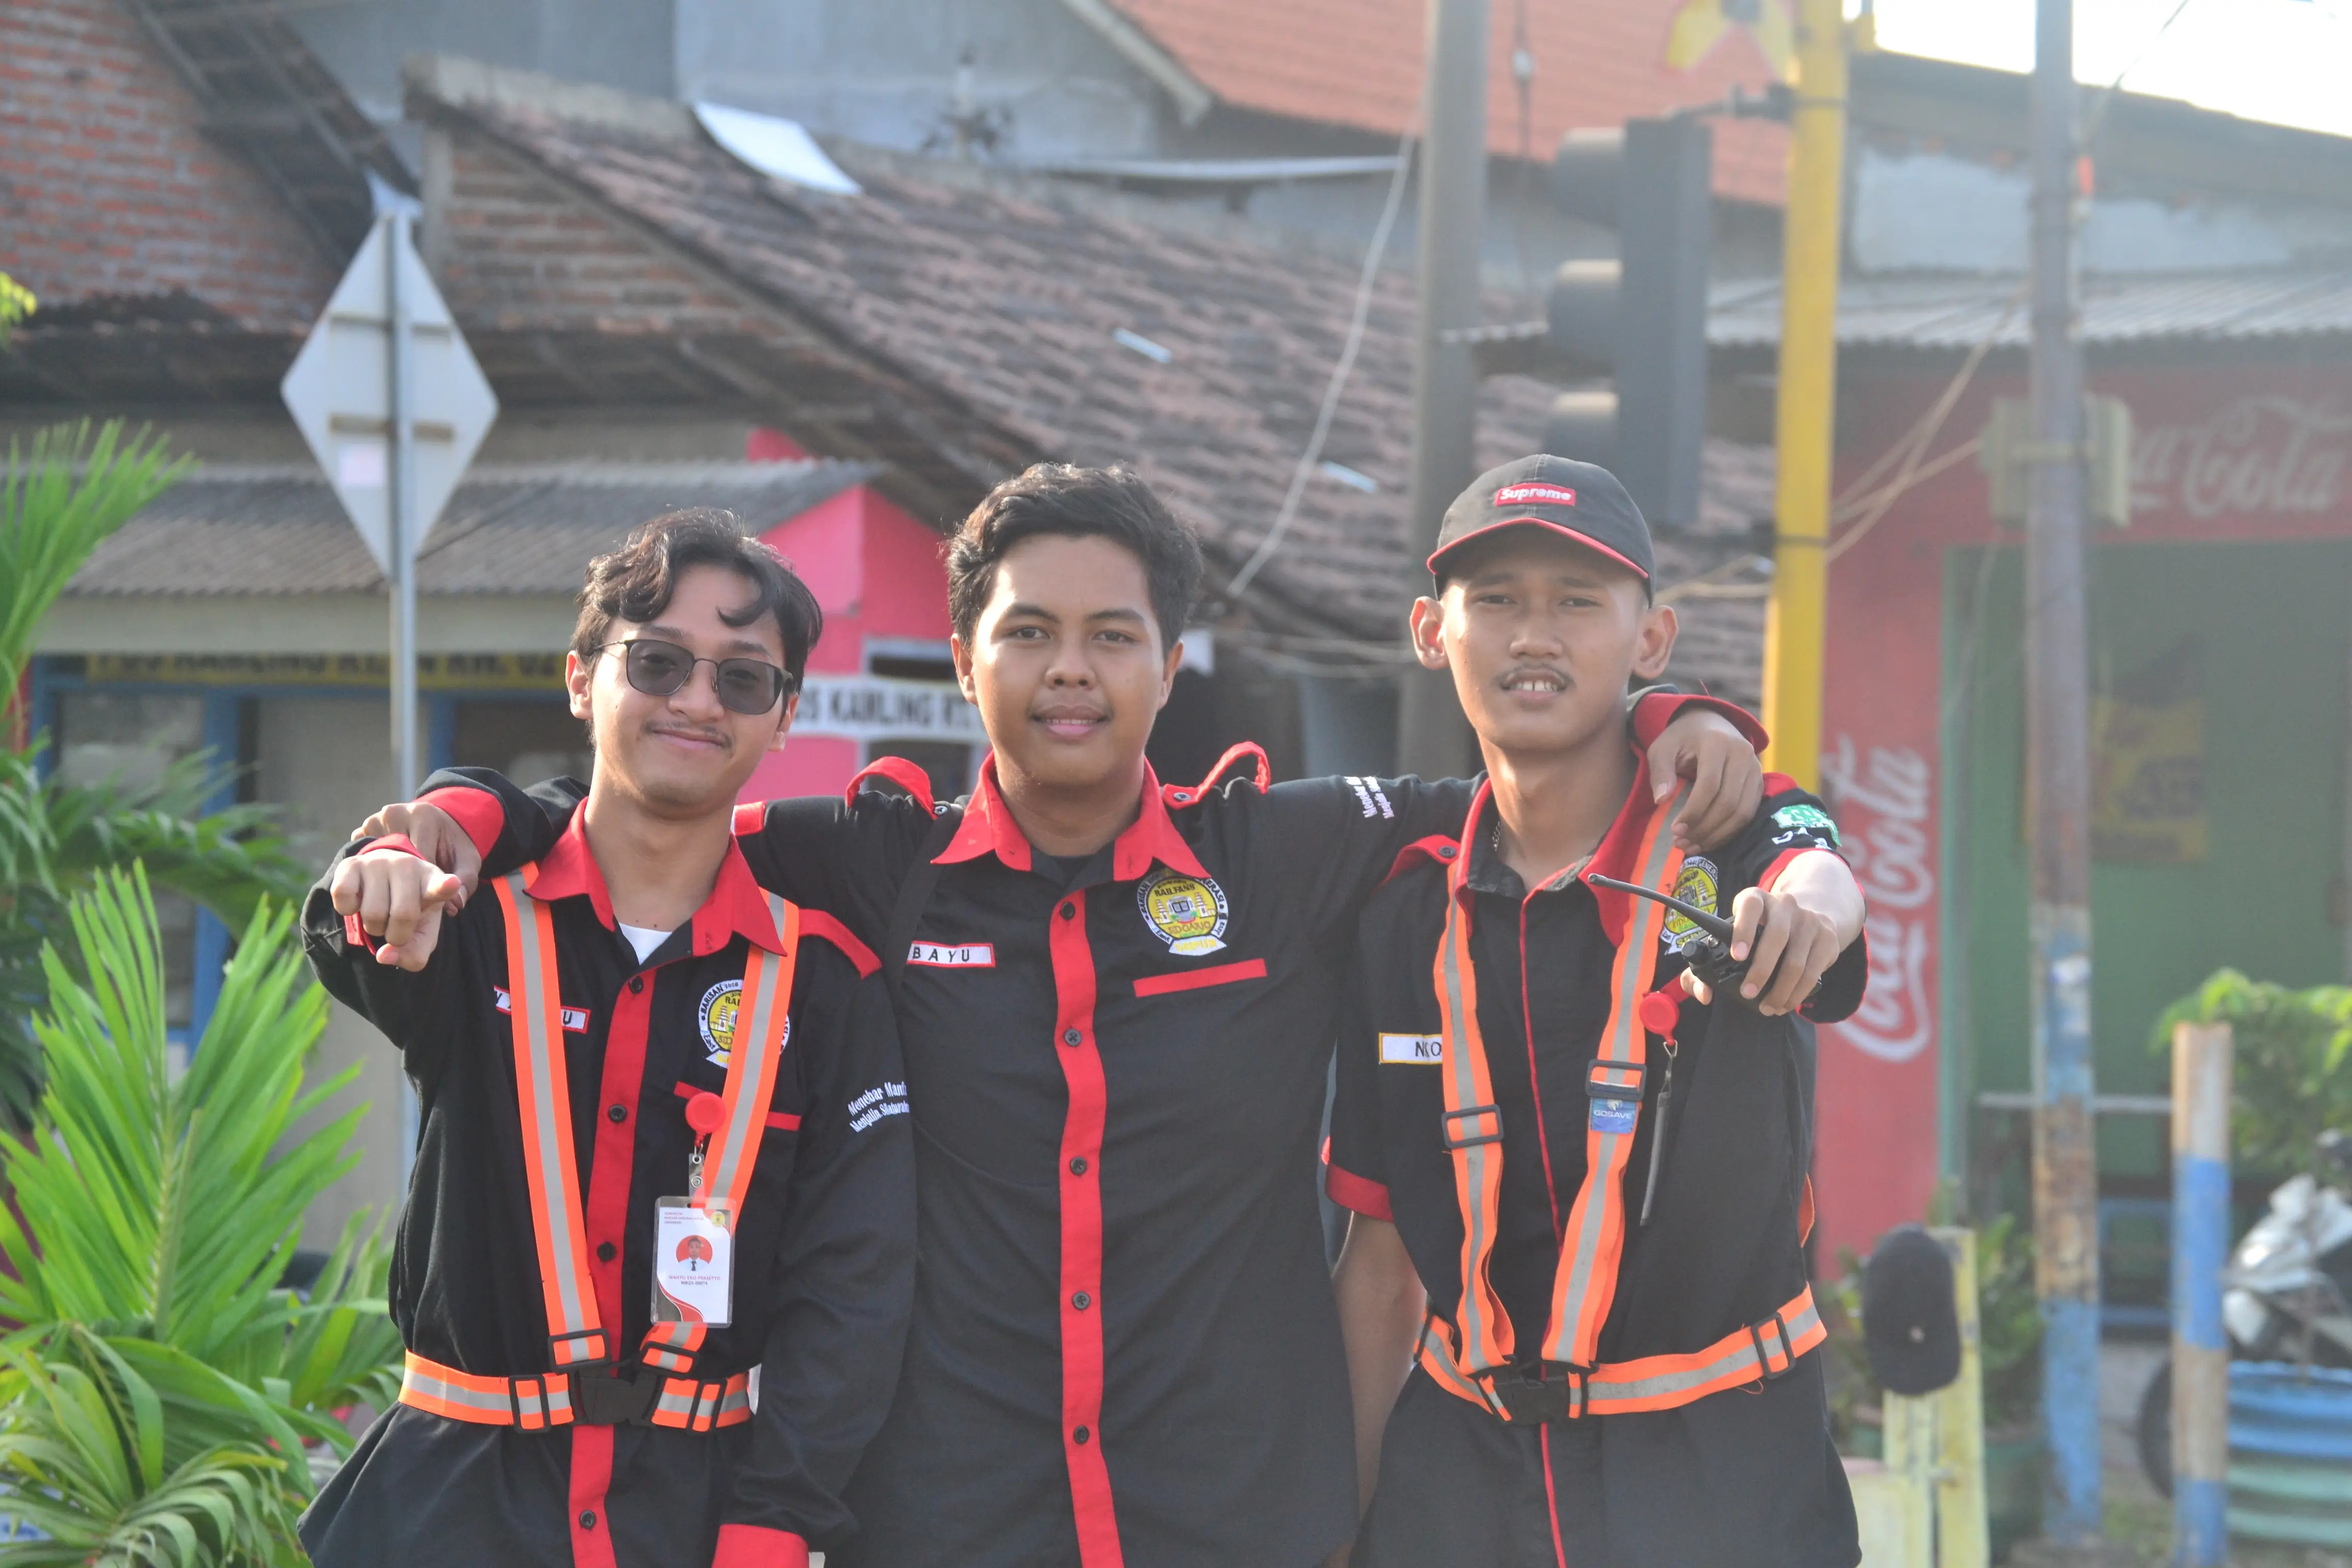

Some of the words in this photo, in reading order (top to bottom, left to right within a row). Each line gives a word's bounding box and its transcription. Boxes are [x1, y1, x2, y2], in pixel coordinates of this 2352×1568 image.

[1500, 487, 1572, 501] Supreme
[1154, 883, 1195, 897] RAILFANS
[1167, 921, 1211, 934] SIDOARJO
[912, 946, 970, 963] BAYU
[700, 984, 724, 1014] BARISAN
[847, 1087, 884, 1116] Menebar
[1593, 1109, 1633, 1119] GOSAVE
